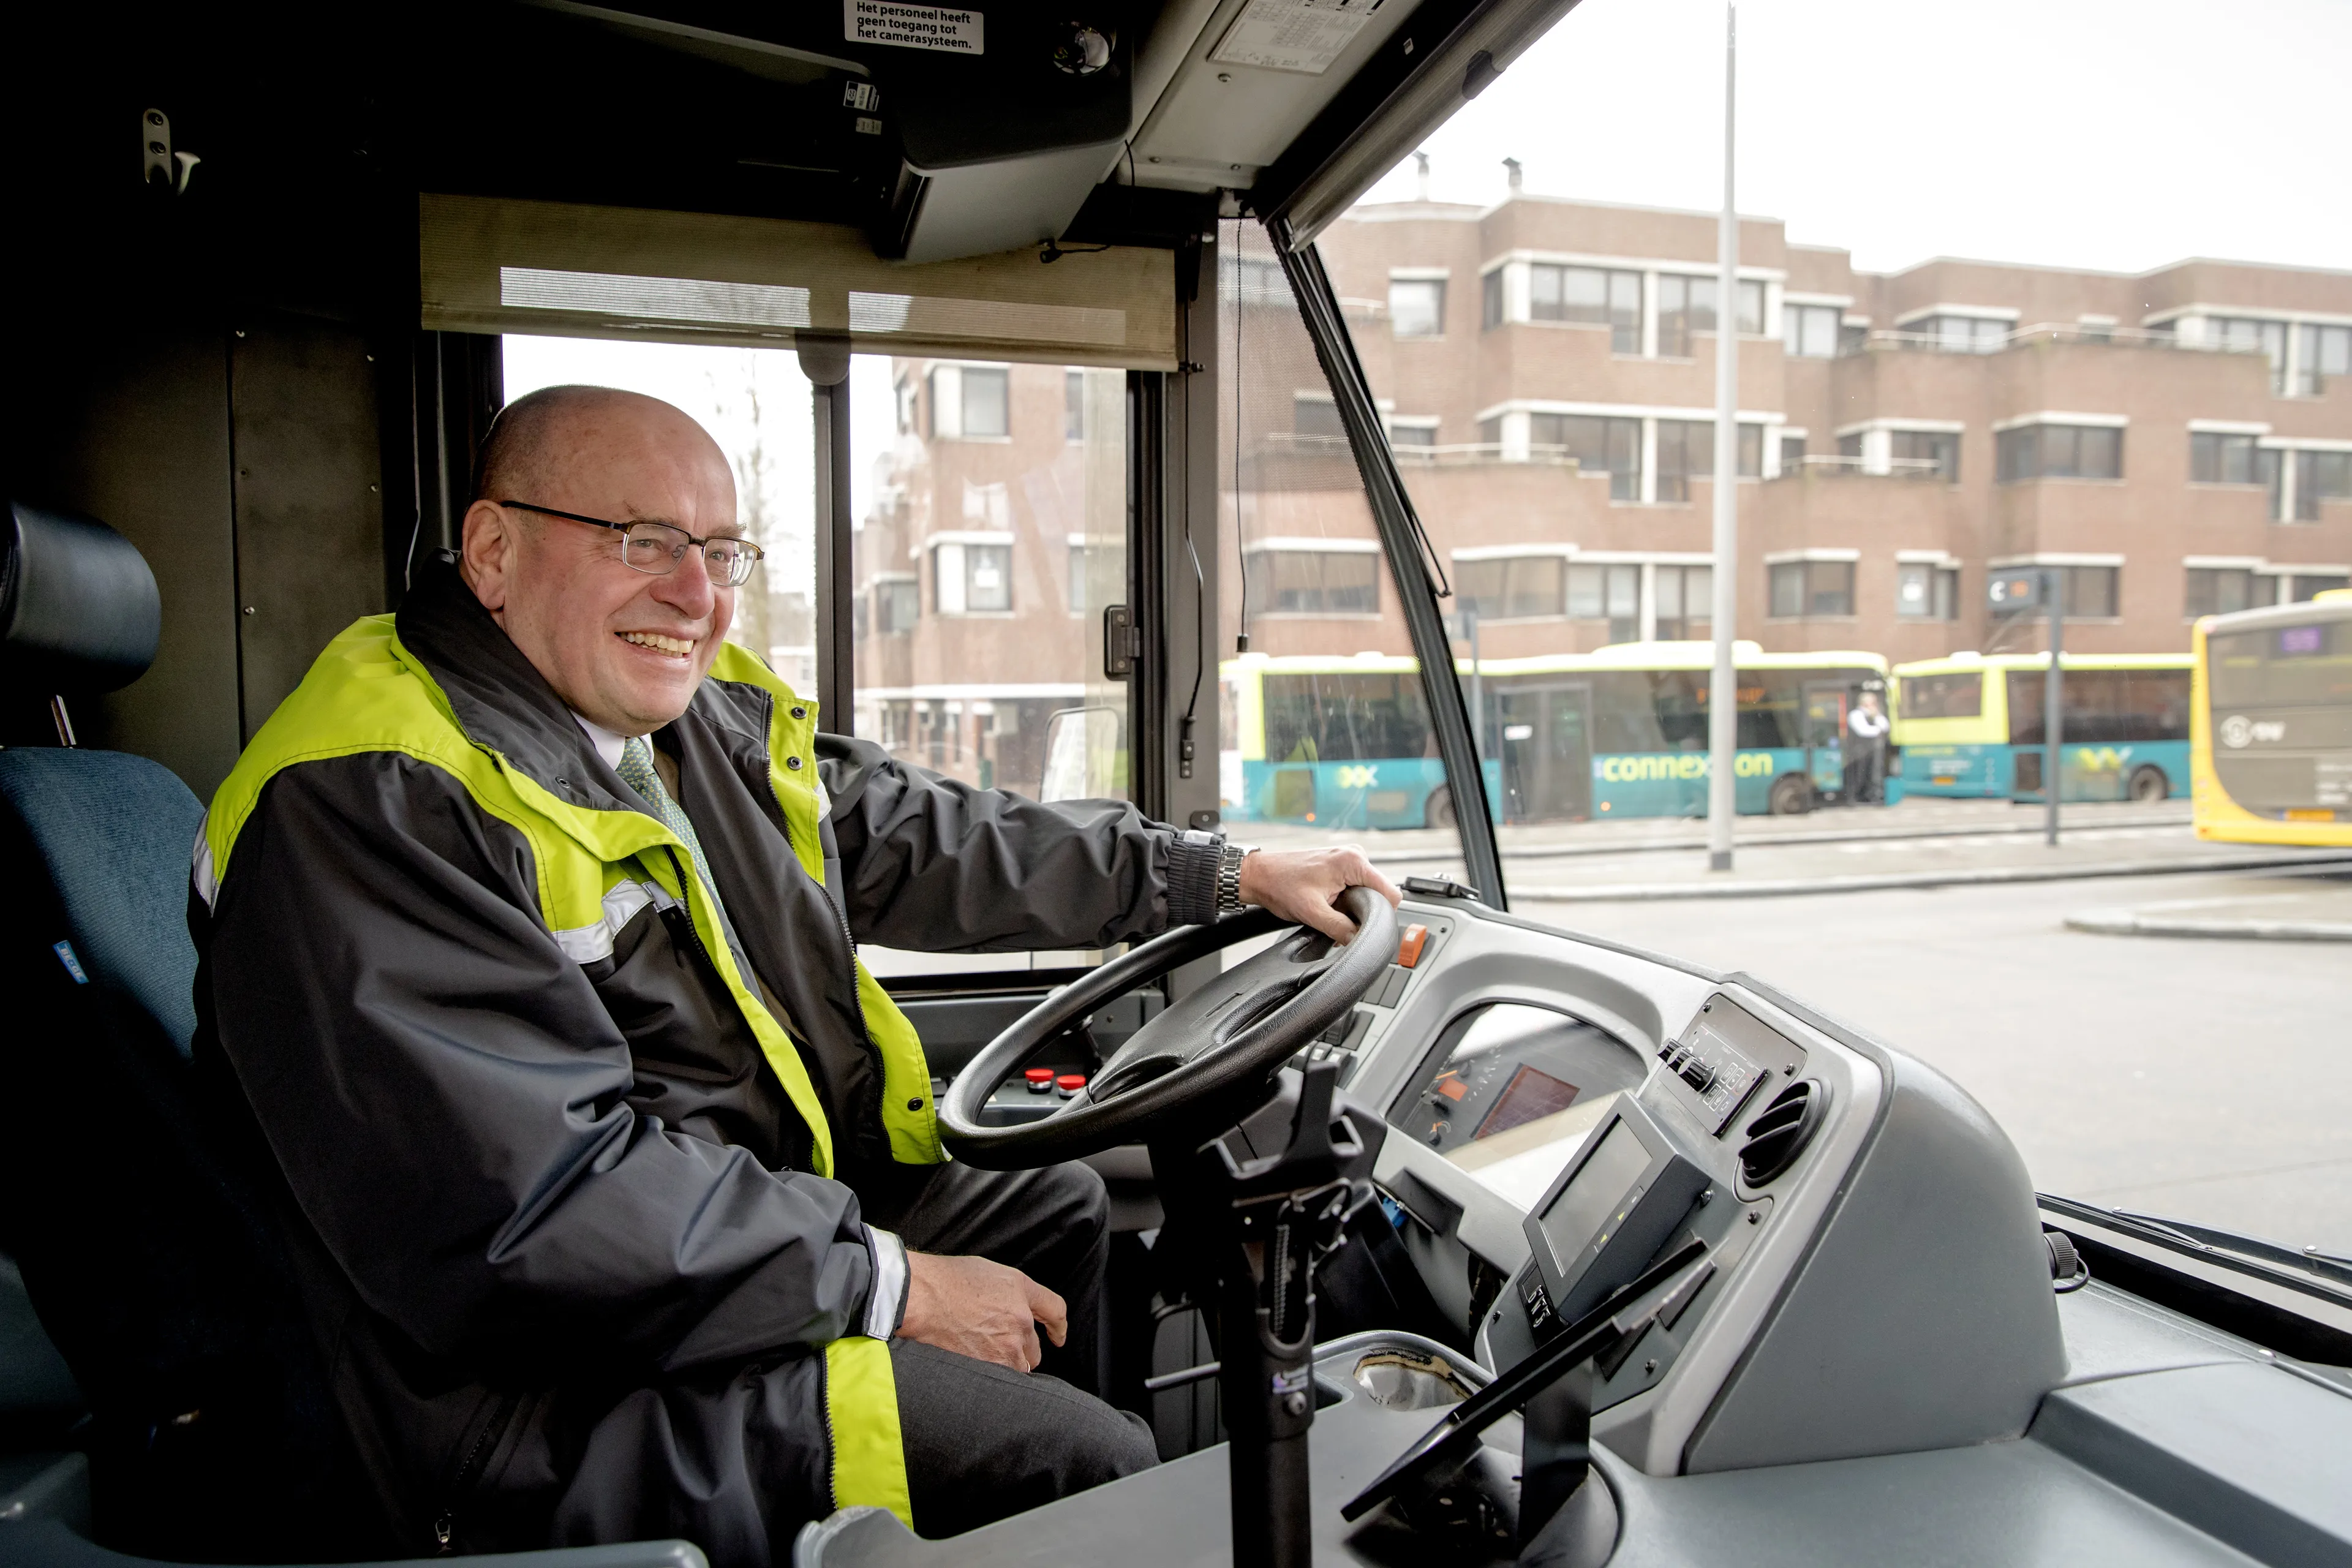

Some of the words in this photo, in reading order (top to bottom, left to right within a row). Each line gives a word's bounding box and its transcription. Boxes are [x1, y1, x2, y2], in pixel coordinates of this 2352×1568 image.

[857, 2, 878, 13] Het
[880, 6, 938, 20] personeel
[940, 10, 971, 24] heeft
[857, 17, 886, 27] geen
[889, 19, 937, 35] toegang
[940, 24, 957, 34] tot
[858, 26, 876, 39] het
[880, 31, 972, 49] camerasysteem.
[1603, 753, 1773, 782] connexon
